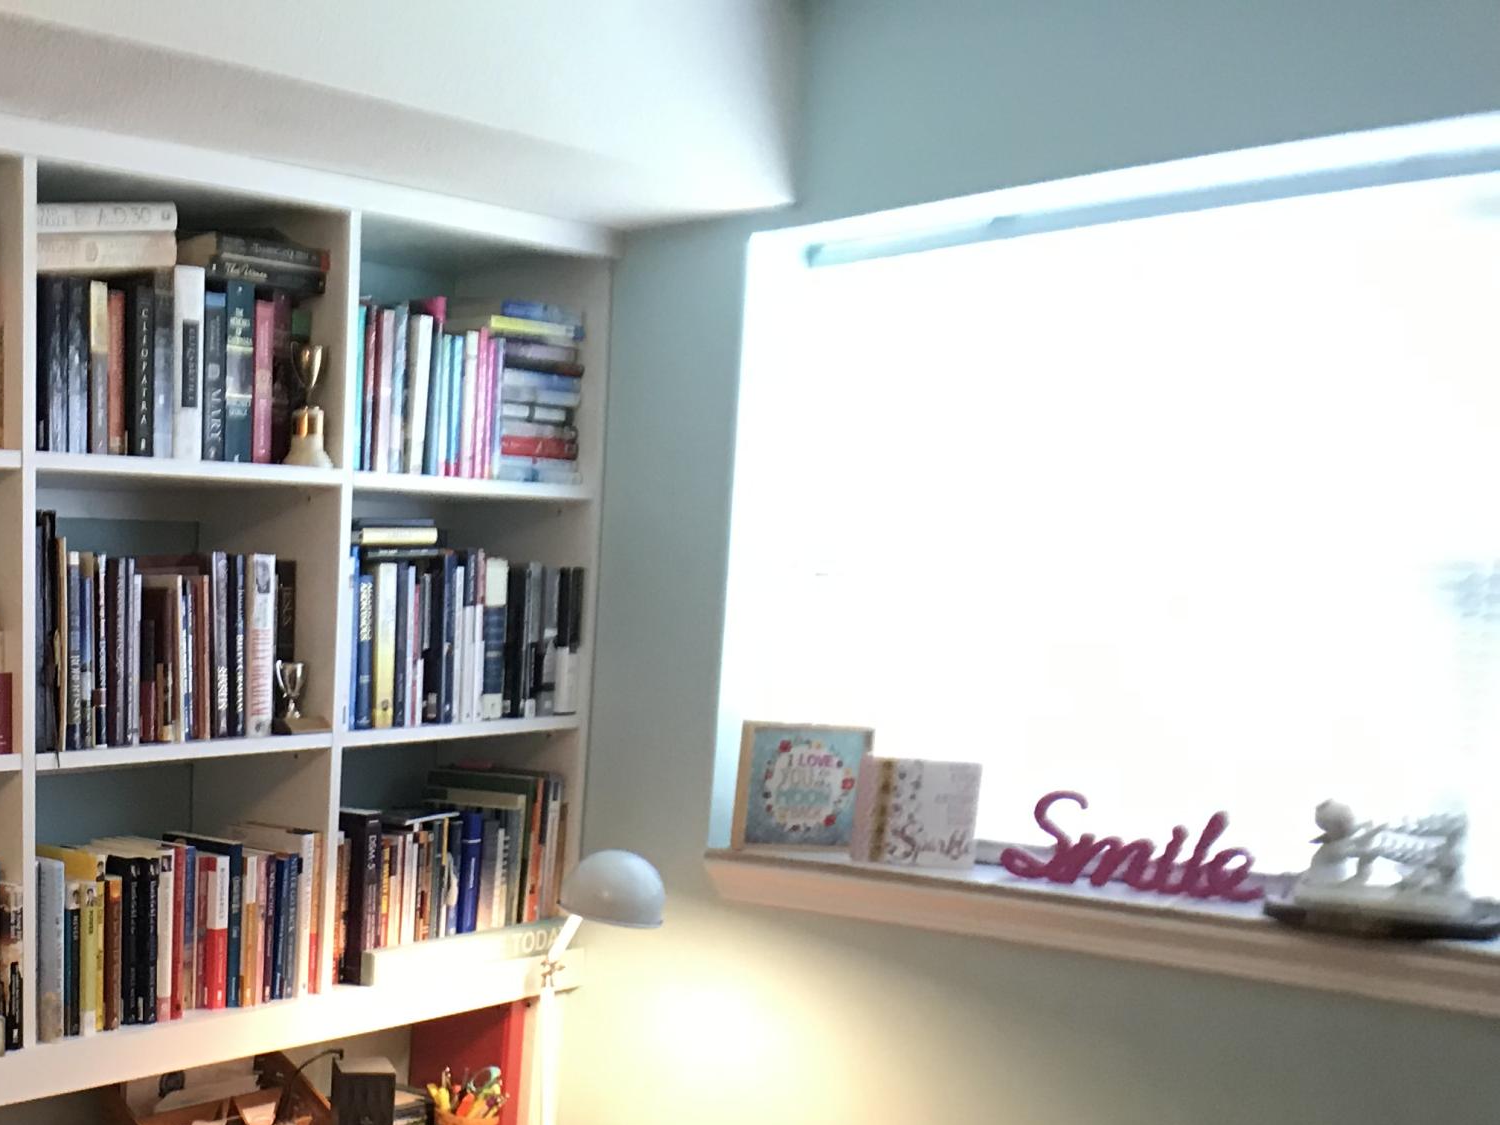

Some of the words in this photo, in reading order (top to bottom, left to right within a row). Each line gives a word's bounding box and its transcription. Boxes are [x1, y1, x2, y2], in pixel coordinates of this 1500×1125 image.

[210, 388, 222, 442] MARY
[252, 628, 271, 664] BILLY
[251, 667, 271, 716] GRAHAM
[779, 768, 814, 787] YOU
[798, 754, 834, 768] LOVE
[367, 834, 377, 871] DSM-5
[999, 790, 1265, 902] Smile
